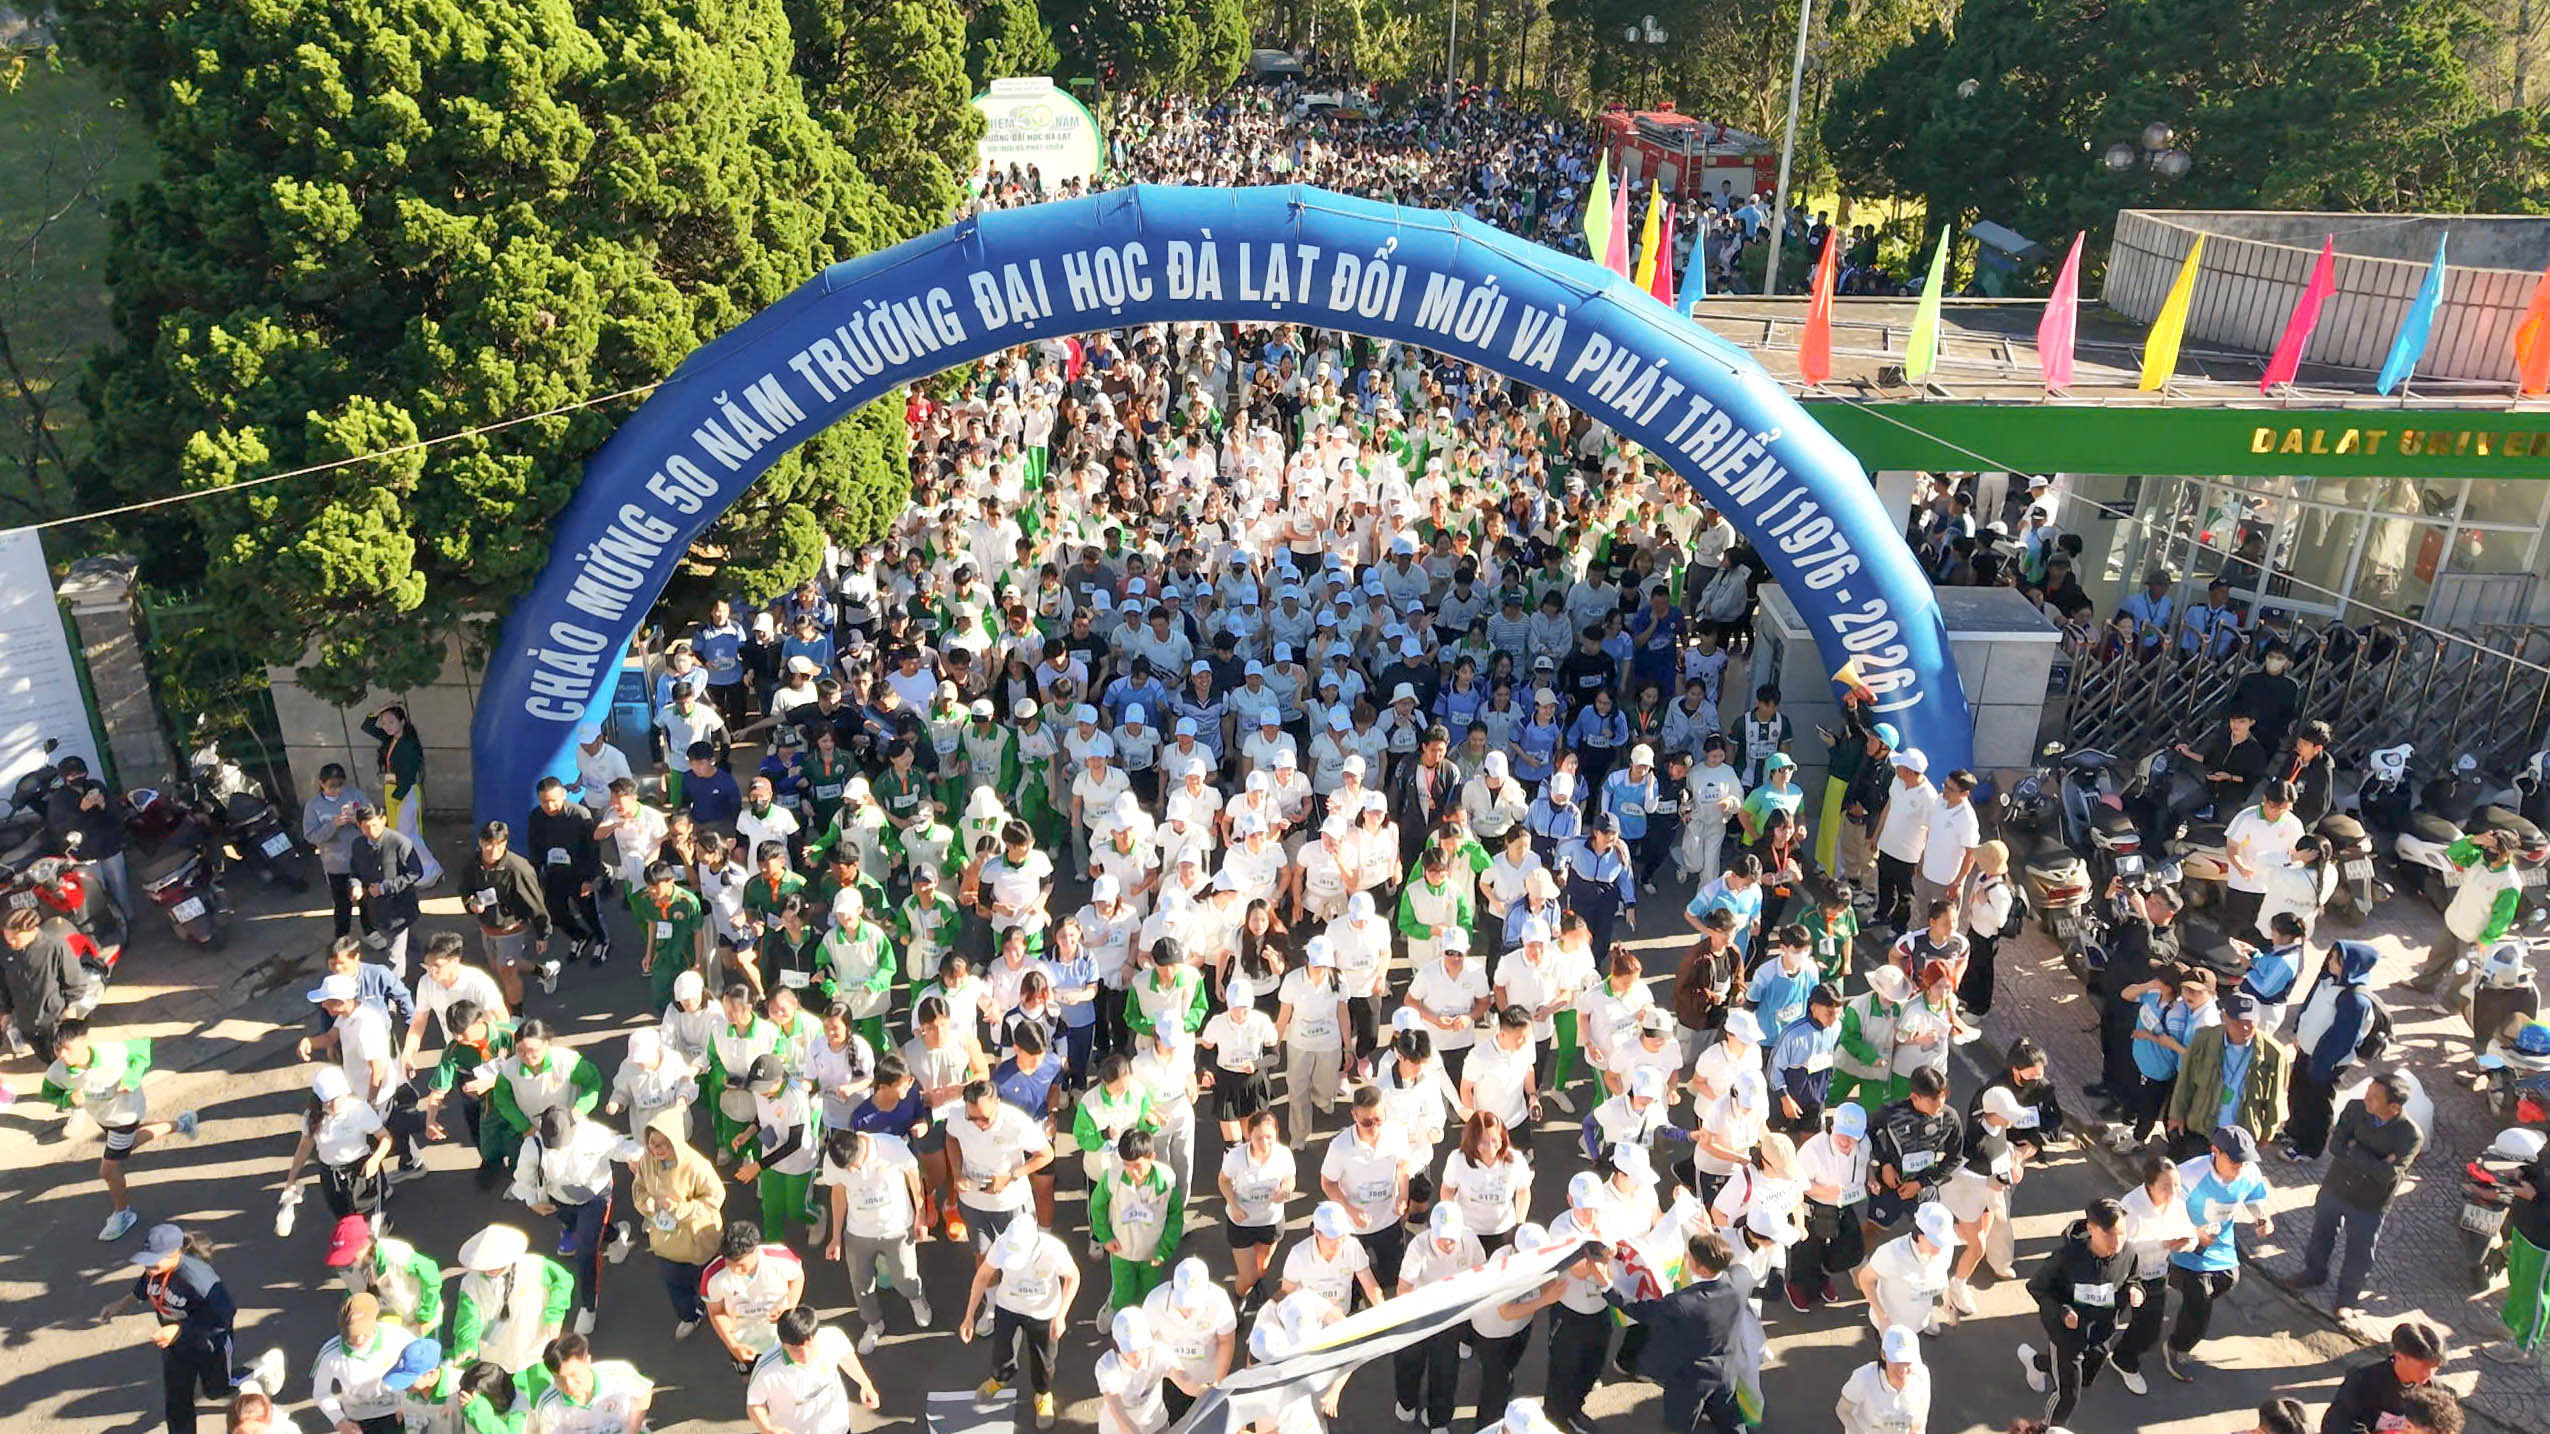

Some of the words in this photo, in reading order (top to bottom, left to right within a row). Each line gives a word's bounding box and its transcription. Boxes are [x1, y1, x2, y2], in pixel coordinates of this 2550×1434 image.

[968, 258, 1053, 330] ĐẠI
[1063, 241, 1152, 321] HỌC
[1167, 228, 1223, 301] ĐÀ
[1239, 242, 1320, 310] LẠT
[1329, 236, 1408, 322] ĐỔI
[788, 287, 968, 403] TRƯỜNG
[1414, 271, 1509, 349] MỚI
[1507, 303, 1568, 373] VÀ
[691, 372, 807, 472] NĂM
[1565, 331, 1686, 427] PHÁT
[645, 454, 719, 514] 50
[1664, 394, 1788, 508] TRIỂN
[2251, 427, 2388, 455] DALAT
[565, 503, 678, 621] MỪNG
[1756, 486, 1860, 590] (1976
[525, 621, 608, 722] CHÀO
[1829, 598, 1924, 713] 2026)
